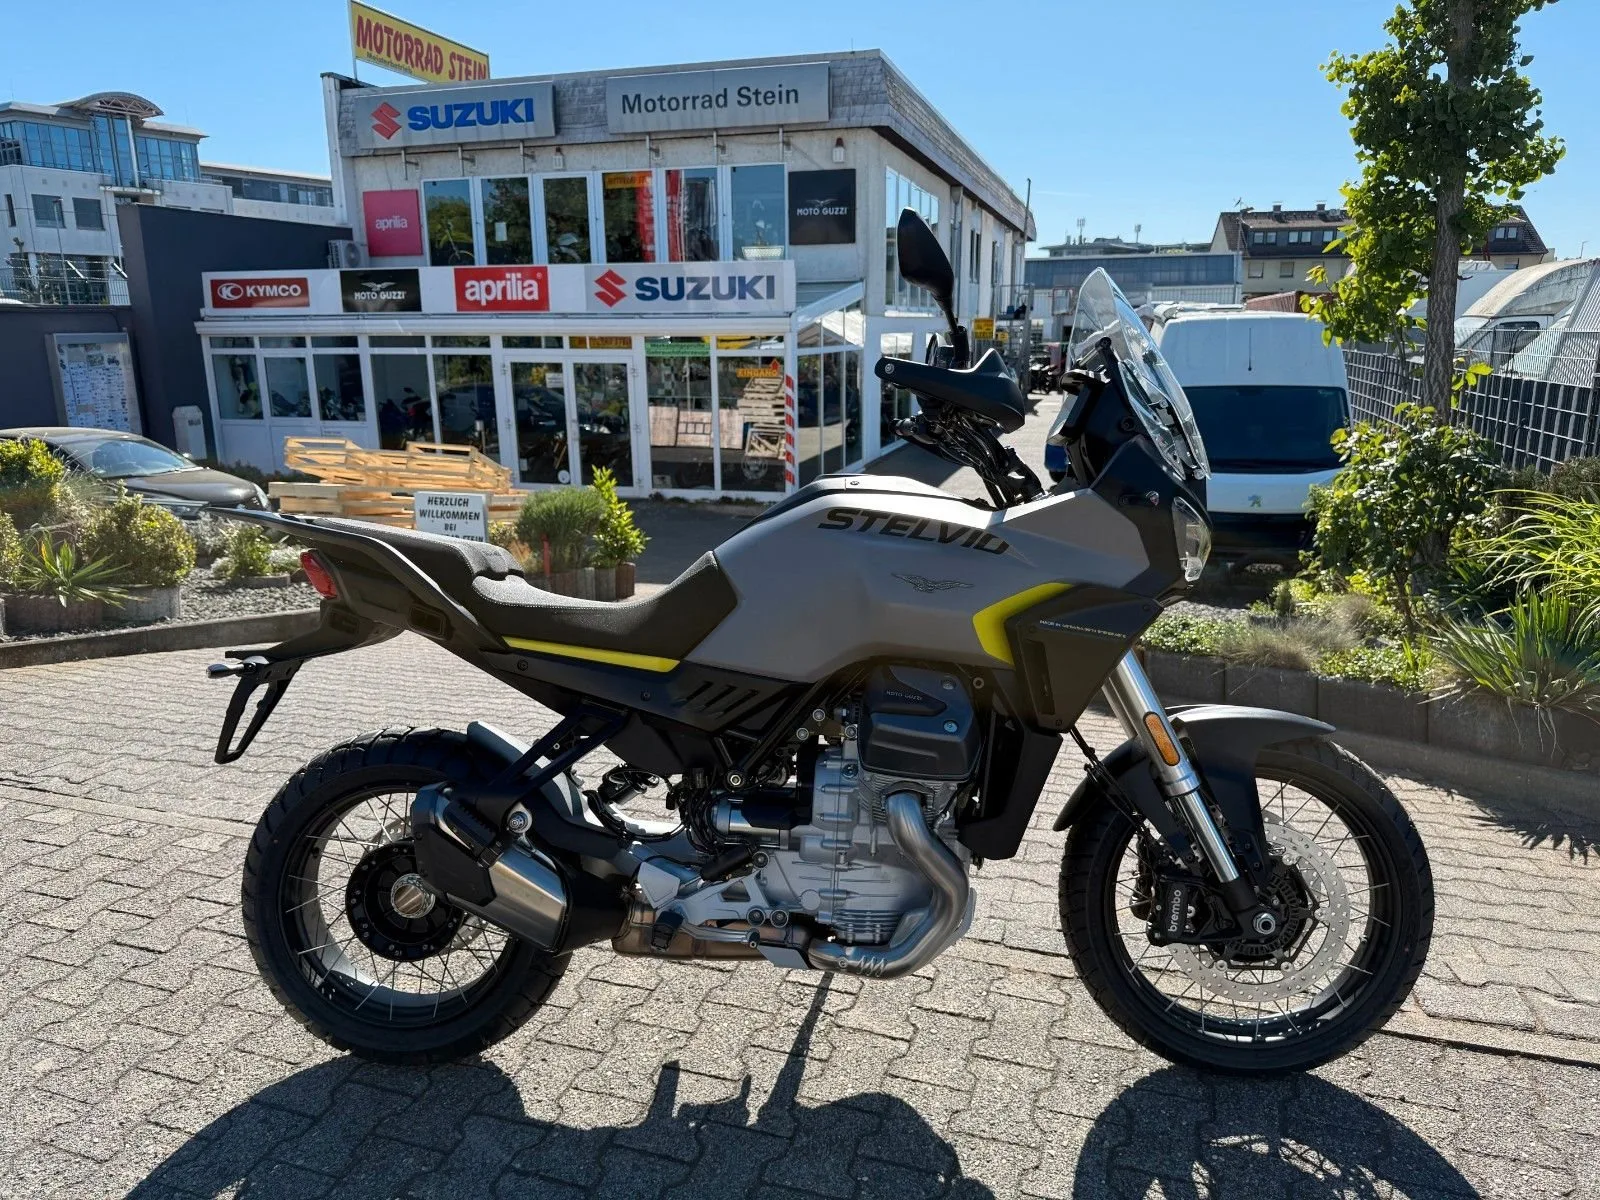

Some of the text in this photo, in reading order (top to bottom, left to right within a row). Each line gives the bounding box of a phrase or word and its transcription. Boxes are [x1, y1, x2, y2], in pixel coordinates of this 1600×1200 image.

[356, 15, 487, 81] MOTORRAD STEIN
[621, 83, 799, 114] Motorrad Stein
[407, 98, 535, 131] SUZUKI
[796, 206, 848, 216] MOTO GUZZI
[375, 215, 408, 231] aprilia
[245, 283, 302, 297] KYMCO
[354, 290, 405, 300] MOTO GUZZI
[464, 272, 539, 306] aprilia
[634, 275, 775, 301] SUZUKI
[427, 496, 470, 507] HERZLICH
[419, 509, 480, 520] WILLKOMMEN
[444, 523, 457, 531] BEI
[818, 506, 1010, 555] STELVIO
[1168, 889, 1182, 932] brembo
